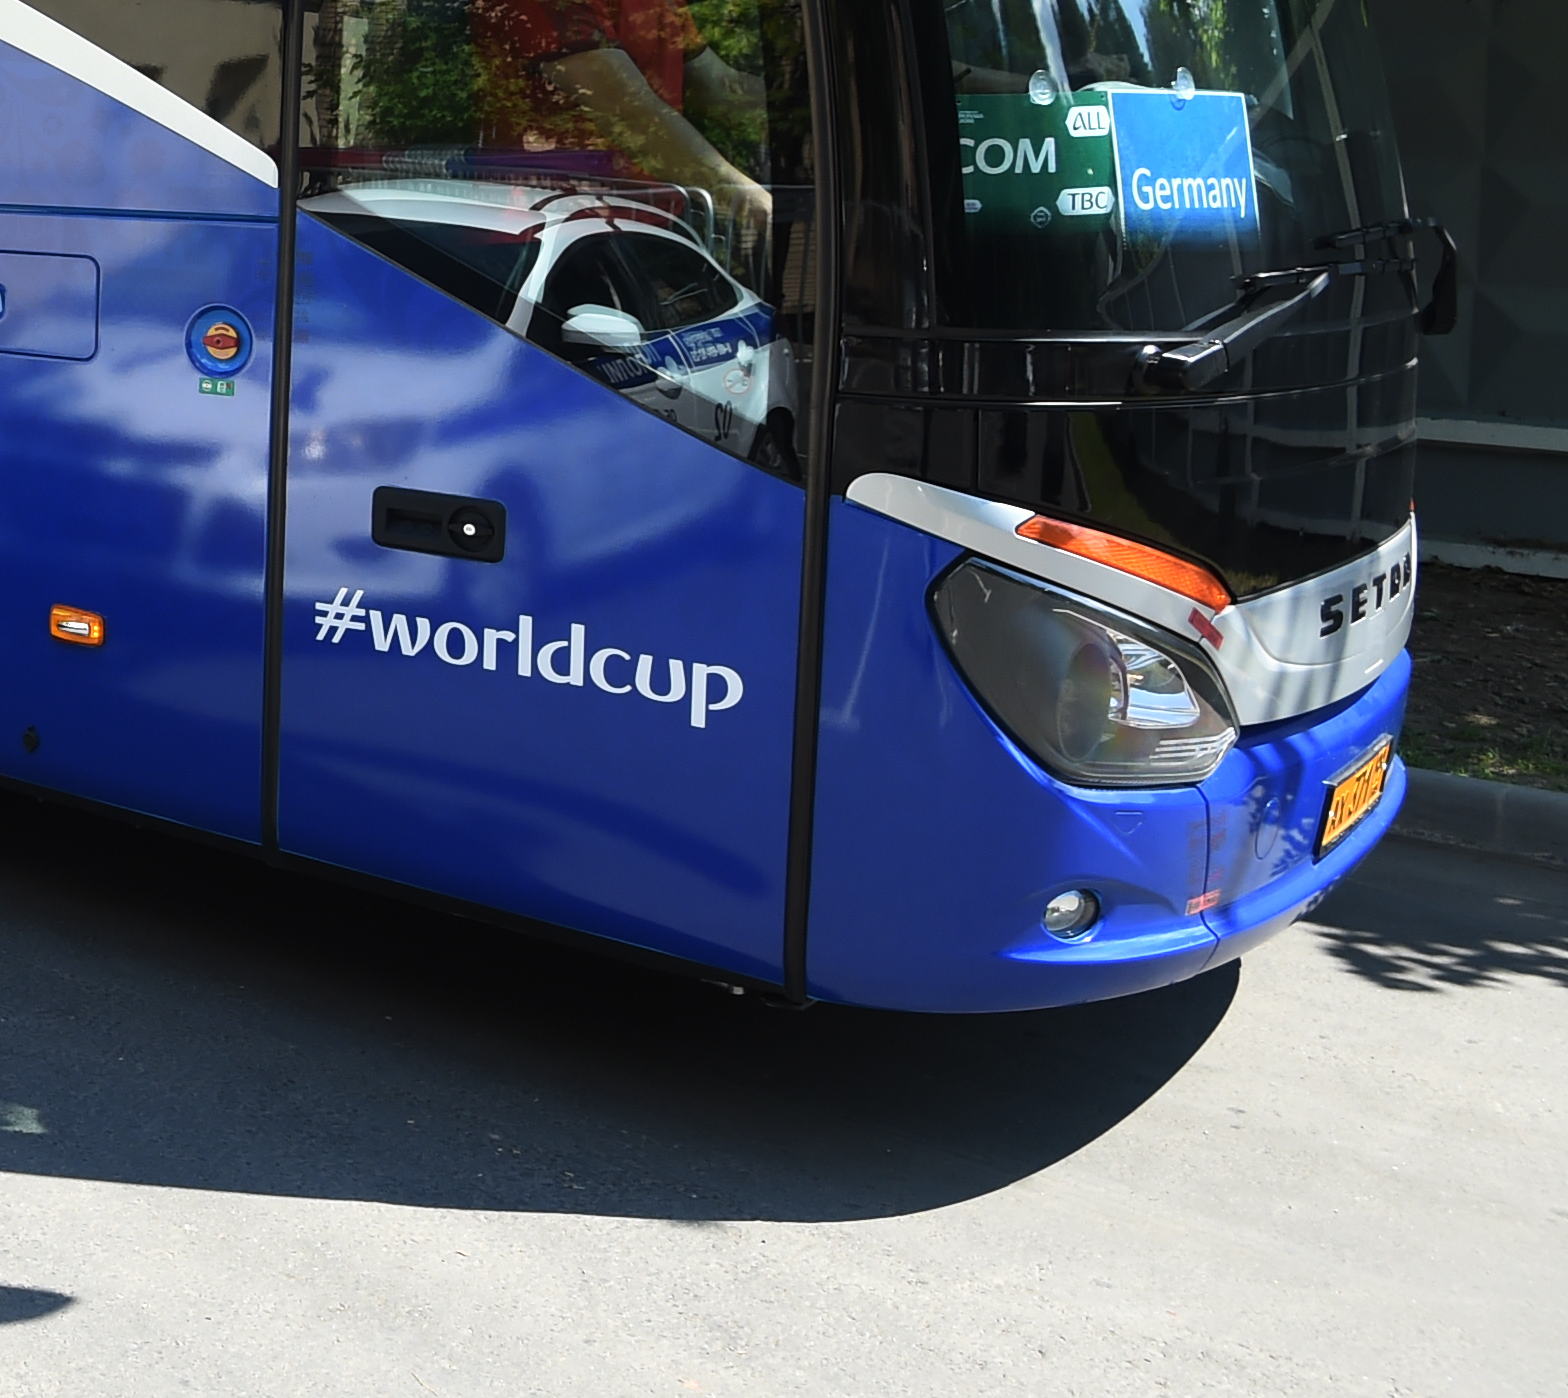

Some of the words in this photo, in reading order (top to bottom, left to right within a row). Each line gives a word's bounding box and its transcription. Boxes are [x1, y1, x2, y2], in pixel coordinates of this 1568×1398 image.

[1072, 111, 1106, 132] ALL
[1066, 192, 1108, 212] TBC
[1131, 167, 1247, 219] Germany
[314, 587, 744, 729] #worldcup
